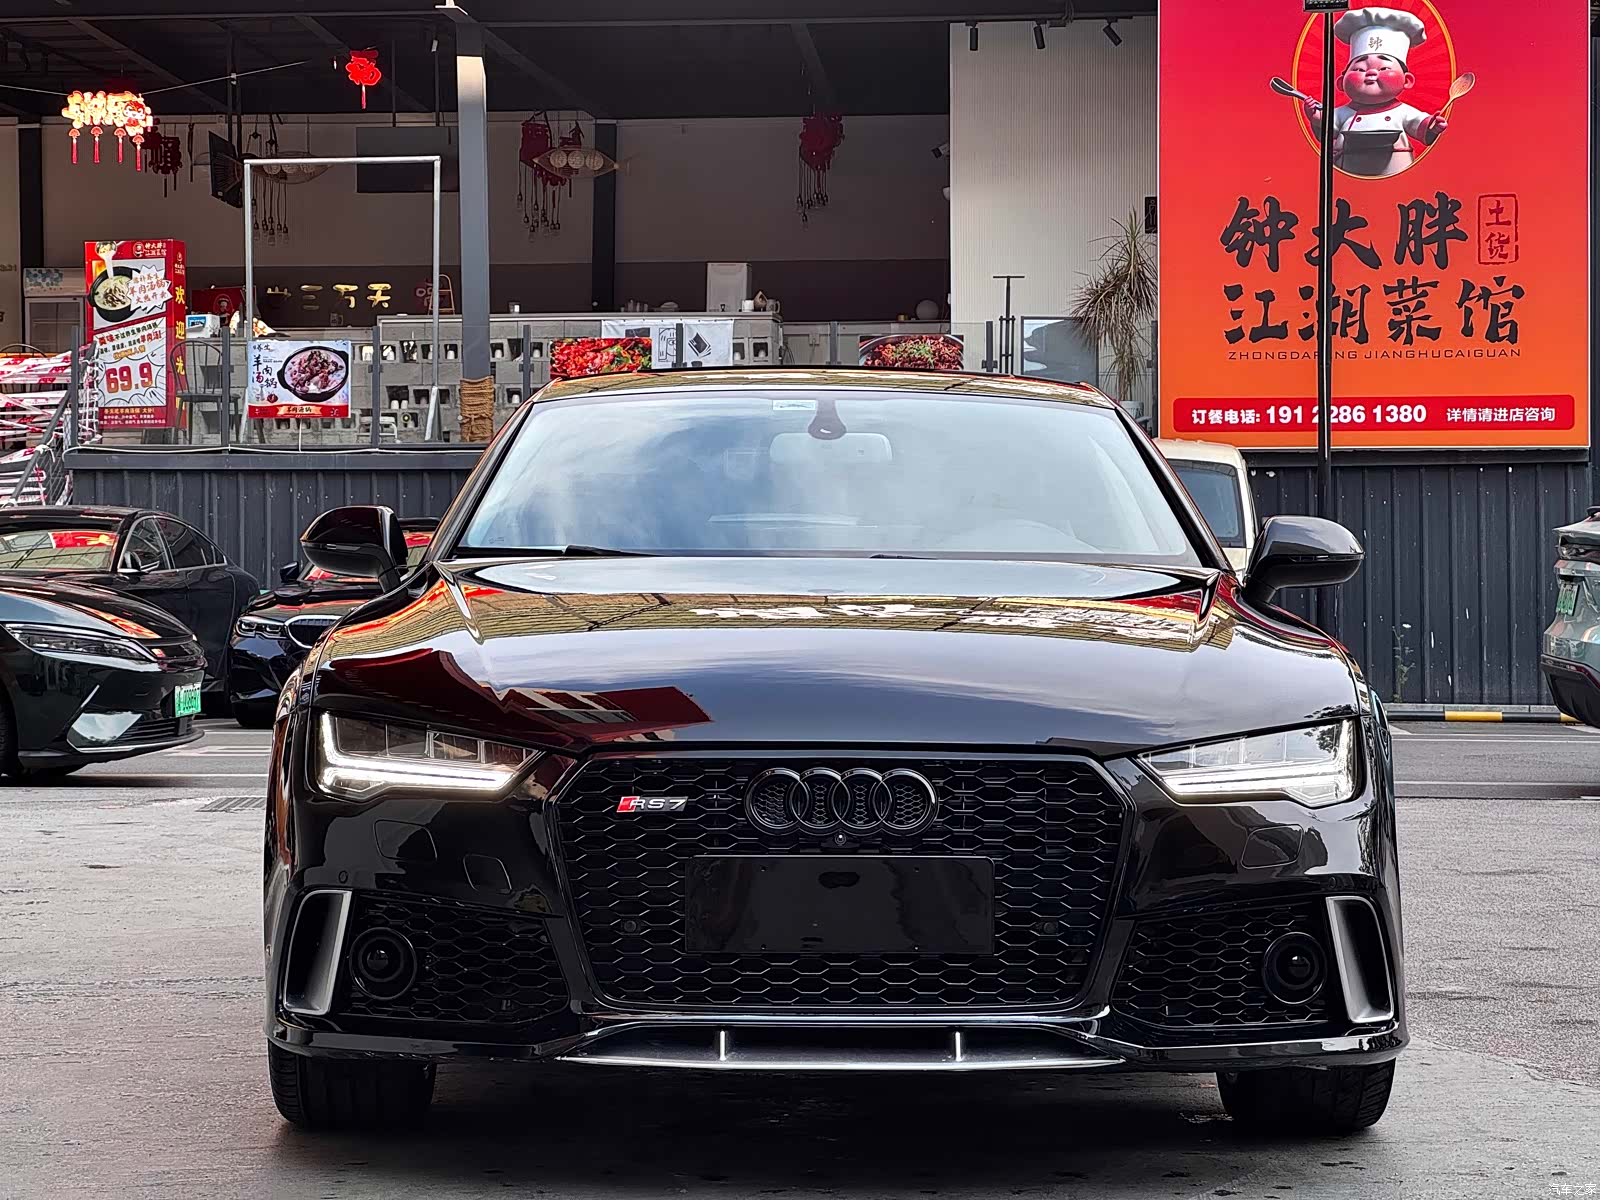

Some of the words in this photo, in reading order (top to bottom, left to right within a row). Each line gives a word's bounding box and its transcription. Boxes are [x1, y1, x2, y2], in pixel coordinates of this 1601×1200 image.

[1219, 191, 1469, 273] 钟大胖
[1484, 199, 1512, 260] 土货
[1222, 275, 1526, 347] 江湖菜馆
[1228, 350, 1358, 361] ZHONGDANG
[1364, 348, 1521, 360] JIANGHUCAIGUAN
[105, 362, 153, 395] 69.9
[1191, 408, 1261, 425] 订餐电话:
[1266, 405, 1303, 424] 191
[1372, 404, 1427, 423] 1380
[1446, 407, 1556, 423] 详情请进店咨询
[625, 798, 686, 810] RS7
